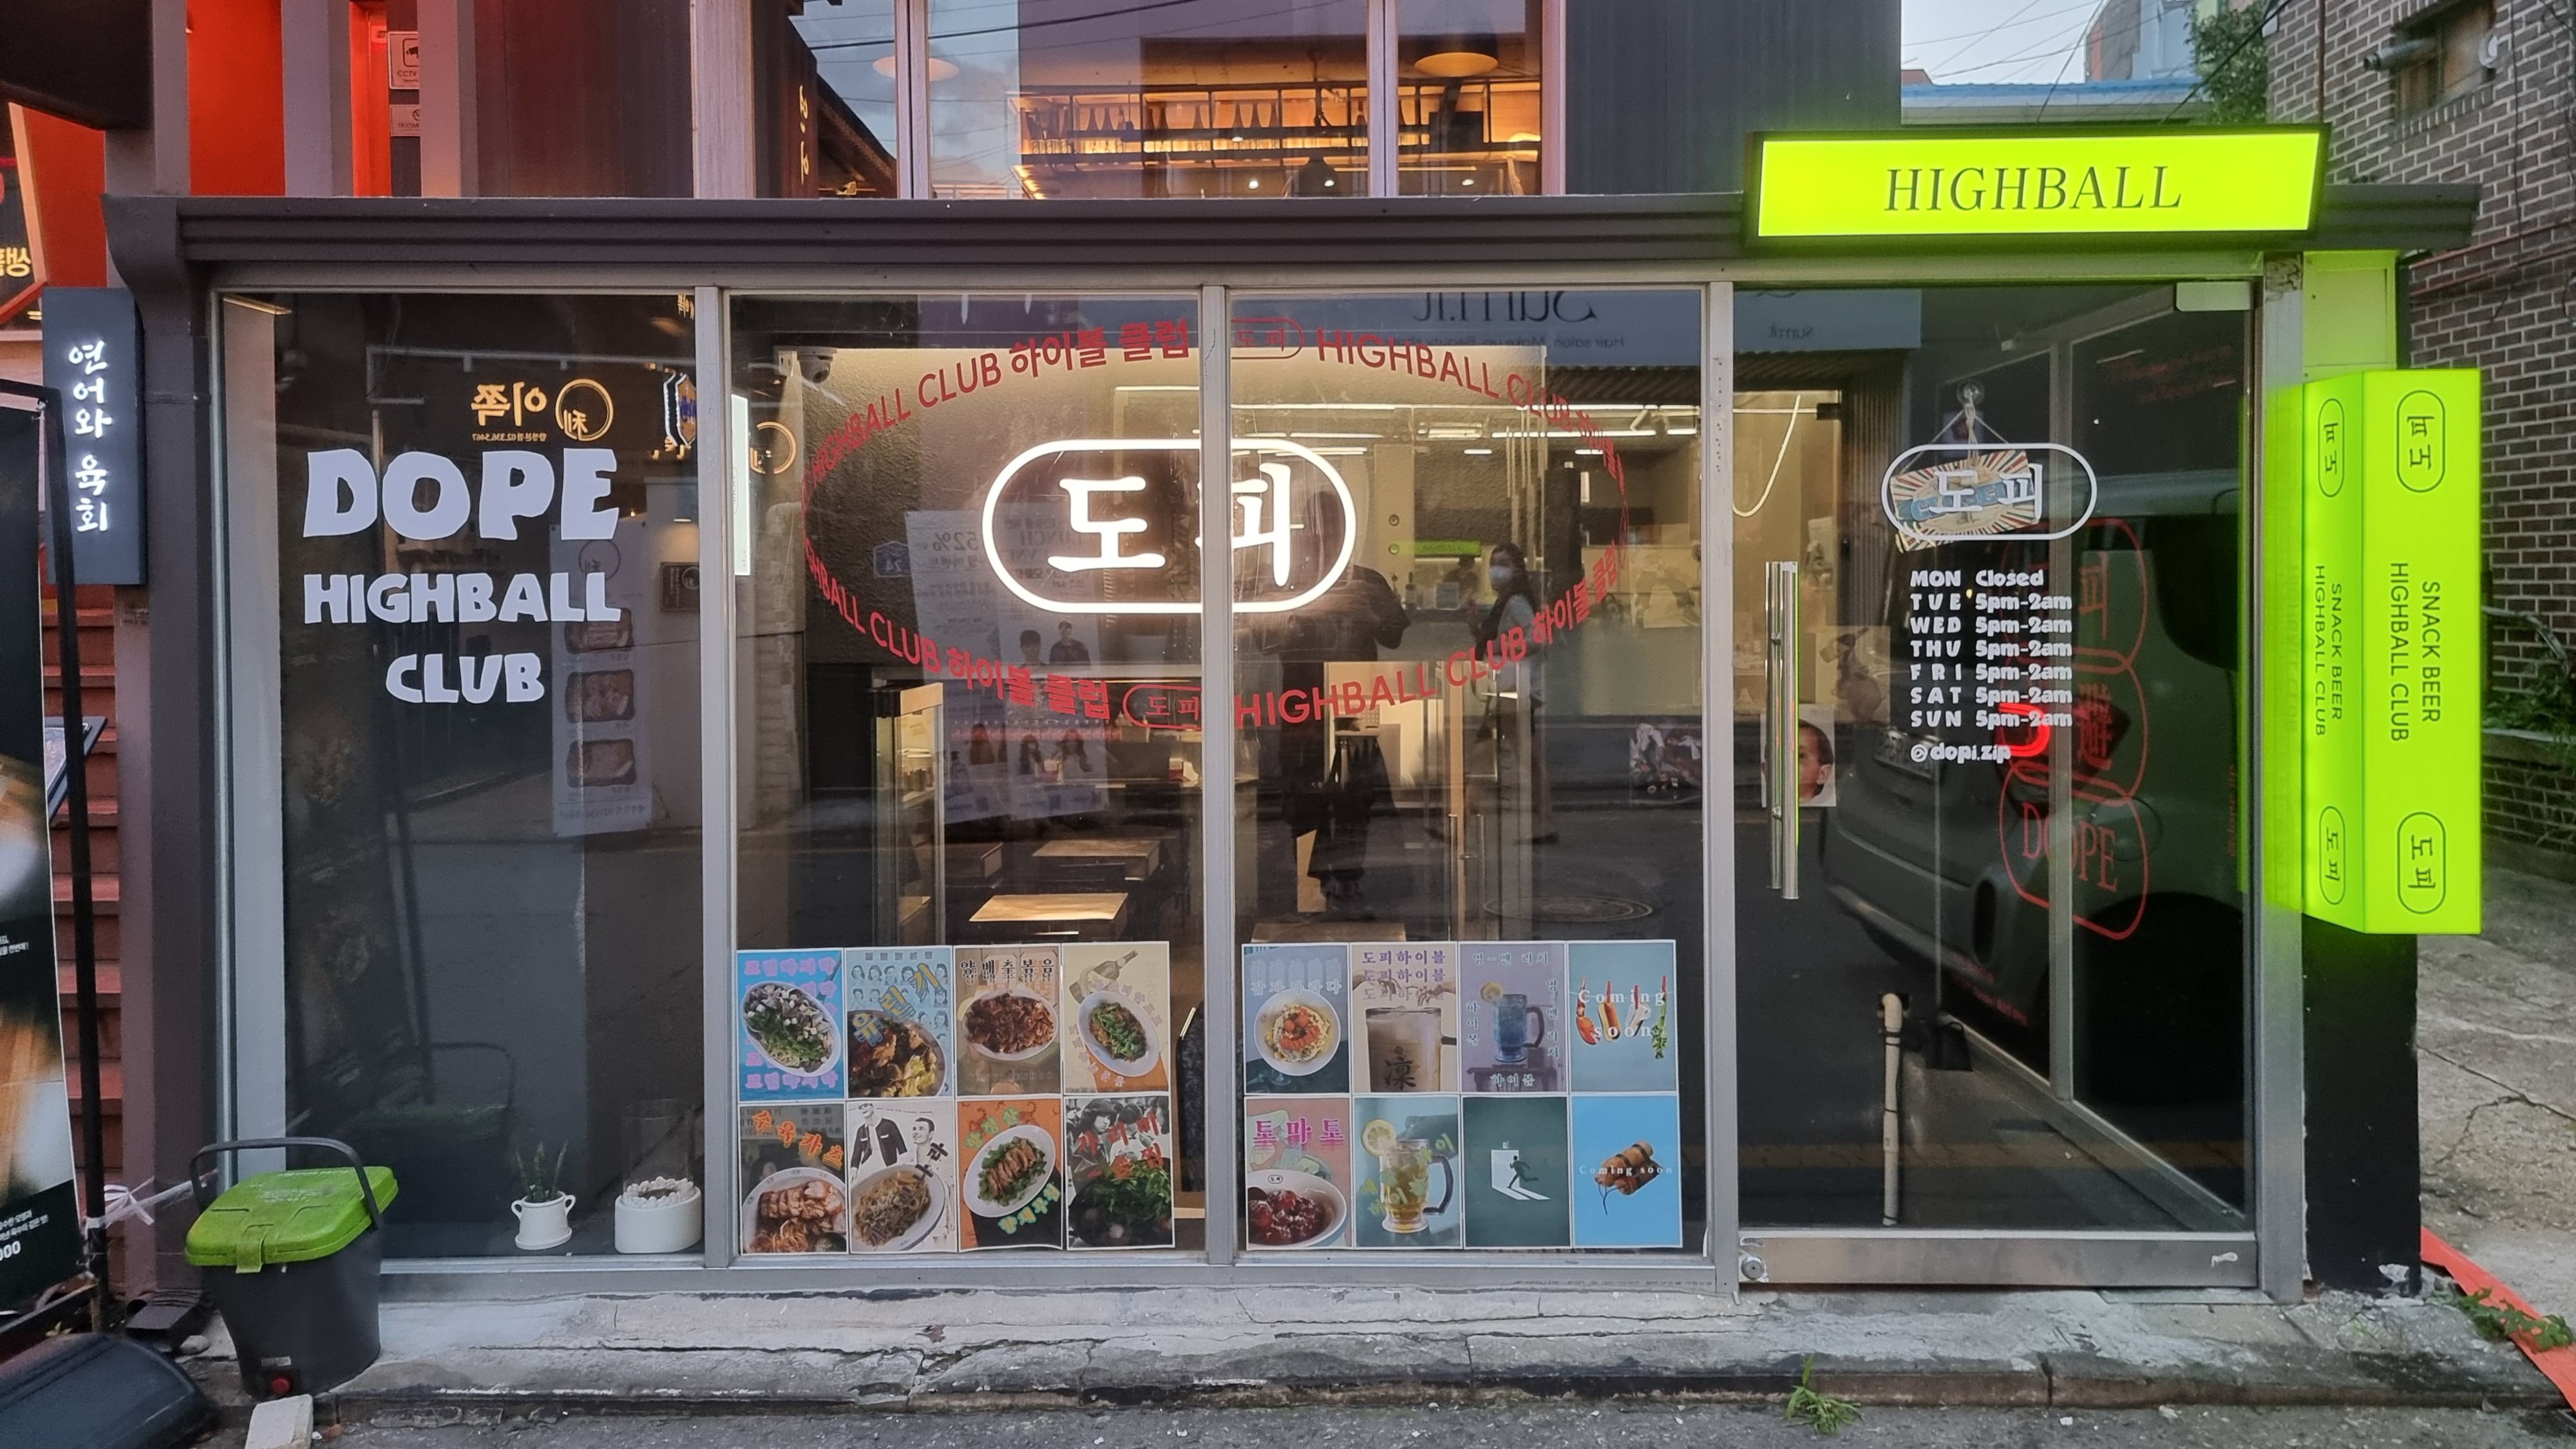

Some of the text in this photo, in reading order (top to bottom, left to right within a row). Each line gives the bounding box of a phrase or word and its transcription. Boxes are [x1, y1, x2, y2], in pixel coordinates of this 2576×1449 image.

[1883, 165, 2182, 212] HIGHBALL
[1236, 327, 1287, 353] 도피
[810, 318, 1189, 489] HIGHBALL CLUB 하이볼 클럽
[1316, 327, 1501, 399] HIGHBALL
[1507, 374, 1573, 432] CLUB
[68, 340, 114, 532] 연어와 육회
[2323, 422, 2340, 475] 도피
[2406, 415, 2436, 471] 도피
[303, 447, 620, 541] DOPE
[1929, 463, 2043, 520] 도피
[1047, 462, 1292, 587] 도피
[303, 572, 621, 624] HIGHBALL
[1910, 569, 2044, 587] MON Closed
[1975, 592, 2072, 613] 5pm-2am
[1234, 664, 1437, 729] HIGHBALL
[1445, 625, 1528, 688] CLUB
[1532, 576, 1591, 645] 하이볼
[1910, 616, 2072, 637] WED 5pm-2am
[1975, 639, 2072, 660] 5pm-2am
[2314, 565, 2326, 736] HIGHBALL CLUB
[2331, 582, 2343, 721] SNACK BEER
[2390, 562, 2409, 742] HIGHBALL CLUB
[2421, 580, 2441, 723] SNACK BEER
[385, 652, 545, 705] CLUB
[870, 612, 941, 674] CLUB
[944, 646, 1034, 707] 하이볼
[1046, 672, 1110, 719] 클럽
[1145, 695, 1200, 721] 도피
[1910, 663, 2072, 684] FRI 5pm-2am
[1910, 687, 2072, 707] SAT 5pm-2am
[1975, 710, 2072, 730] 5pm-2am
[1910, 743, 2011, 764] @dopi.zip
[2325, 826, 2340, 882] 도피
[2407, 834, 2436, 889] 도피
[960, 958, 1055, 978] 양배추볶음
[1362, 950, 1446, 965] 도피하이볼
[1362, 967, 1446, 983] 도피하이볼
[1578, 989, 1667, 1006] Coming
[1594, 1025, 1658, 1038] soon
[1253, 1117, 1345, 1144] 토마토
[1579, 1164, 1672, 1176] Coming soon
